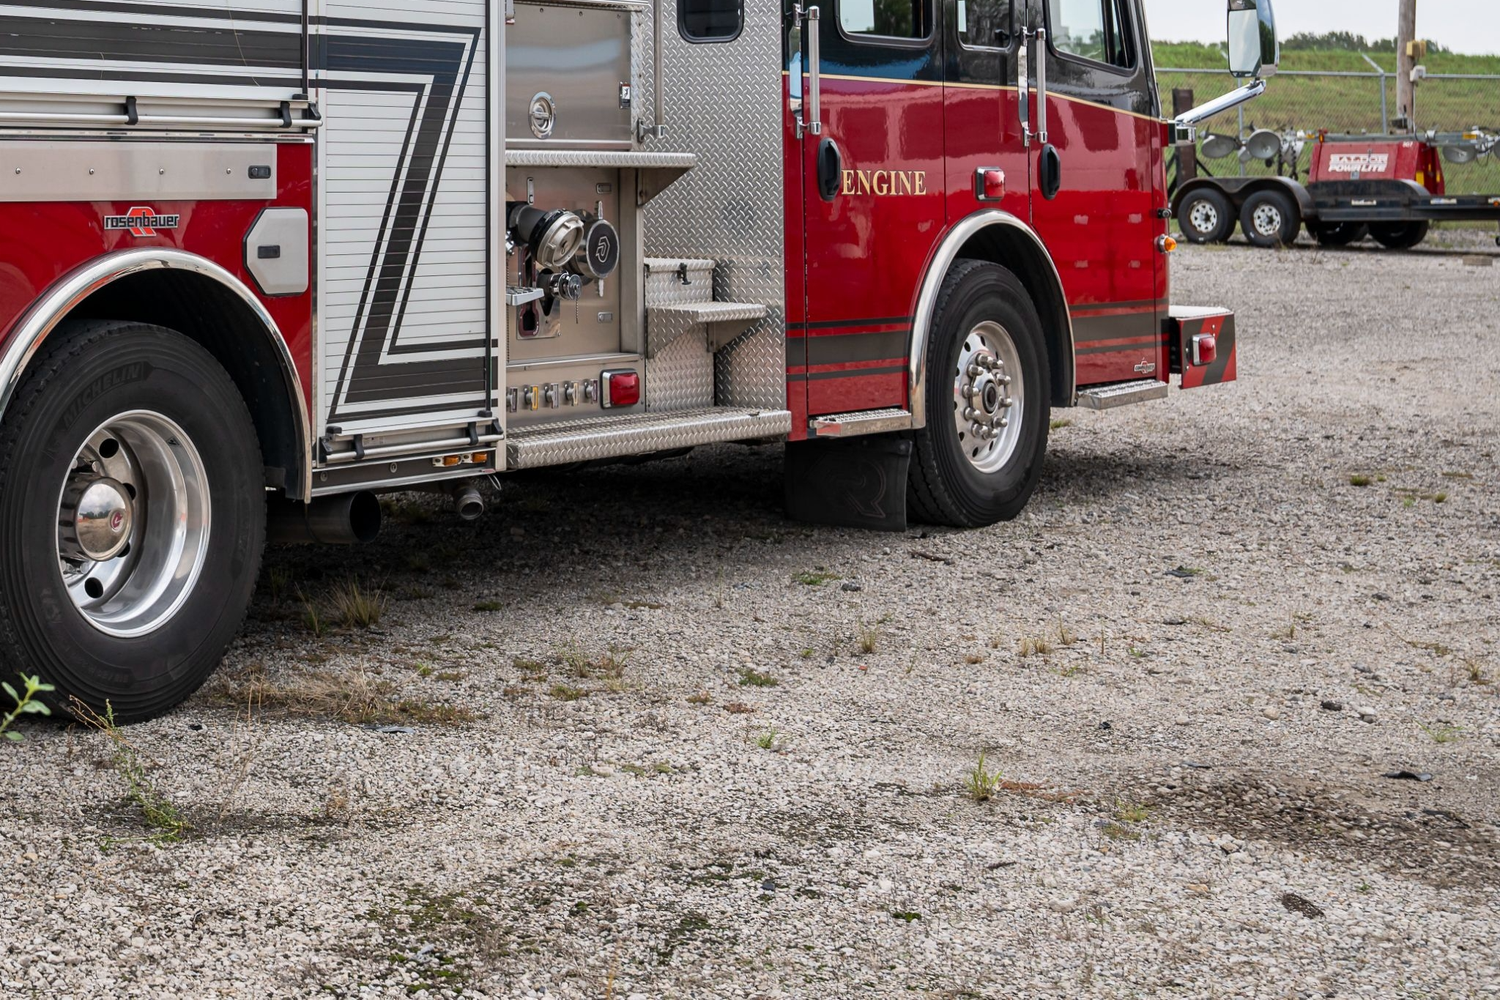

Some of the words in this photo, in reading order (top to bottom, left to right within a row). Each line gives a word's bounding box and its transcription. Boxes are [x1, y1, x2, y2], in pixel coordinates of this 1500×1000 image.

[841, 169, 927, 196] ENGINE
[104, 211, 180, 229] rosenbauer
[62, 361, 142, 430] MICHELIN
